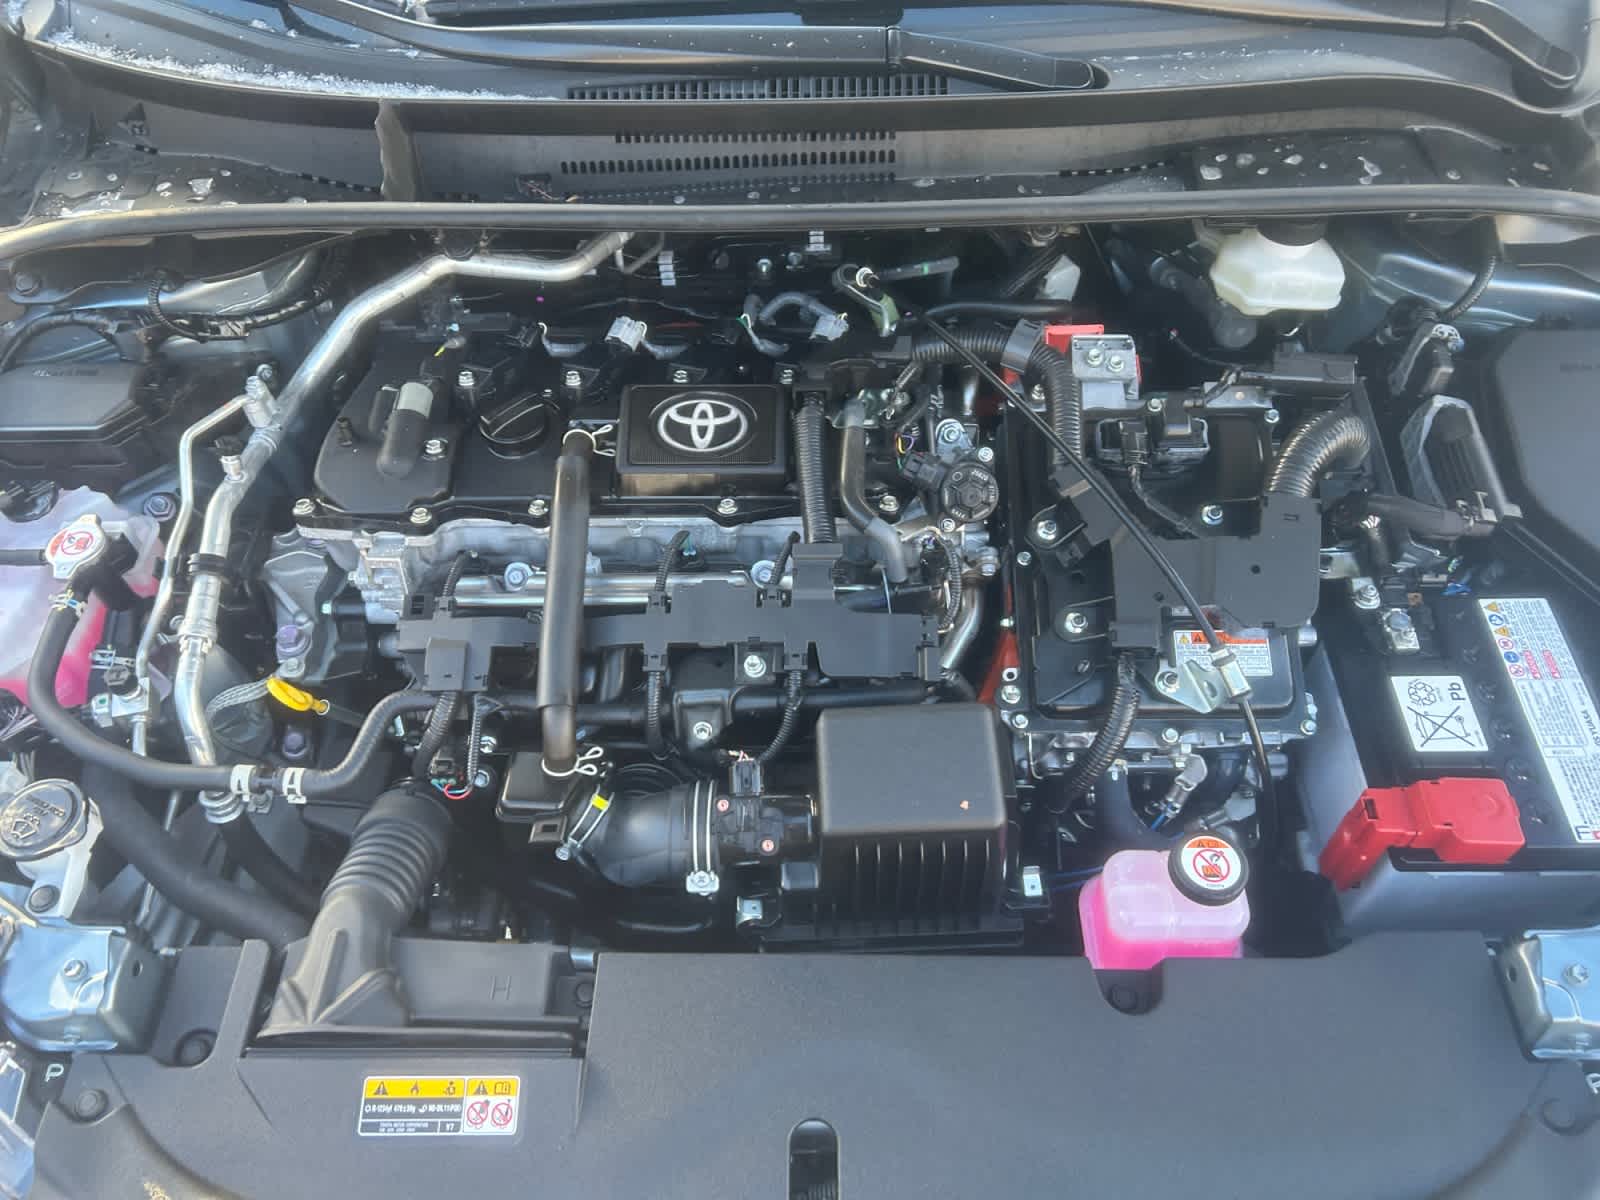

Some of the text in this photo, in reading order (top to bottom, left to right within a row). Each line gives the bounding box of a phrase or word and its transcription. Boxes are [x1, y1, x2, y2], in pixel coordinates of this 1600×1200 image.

[1448, 682, 1466, 701] Pb
[488, 975, 512, 1001] H
[44, 1063, 64, 1083] P
